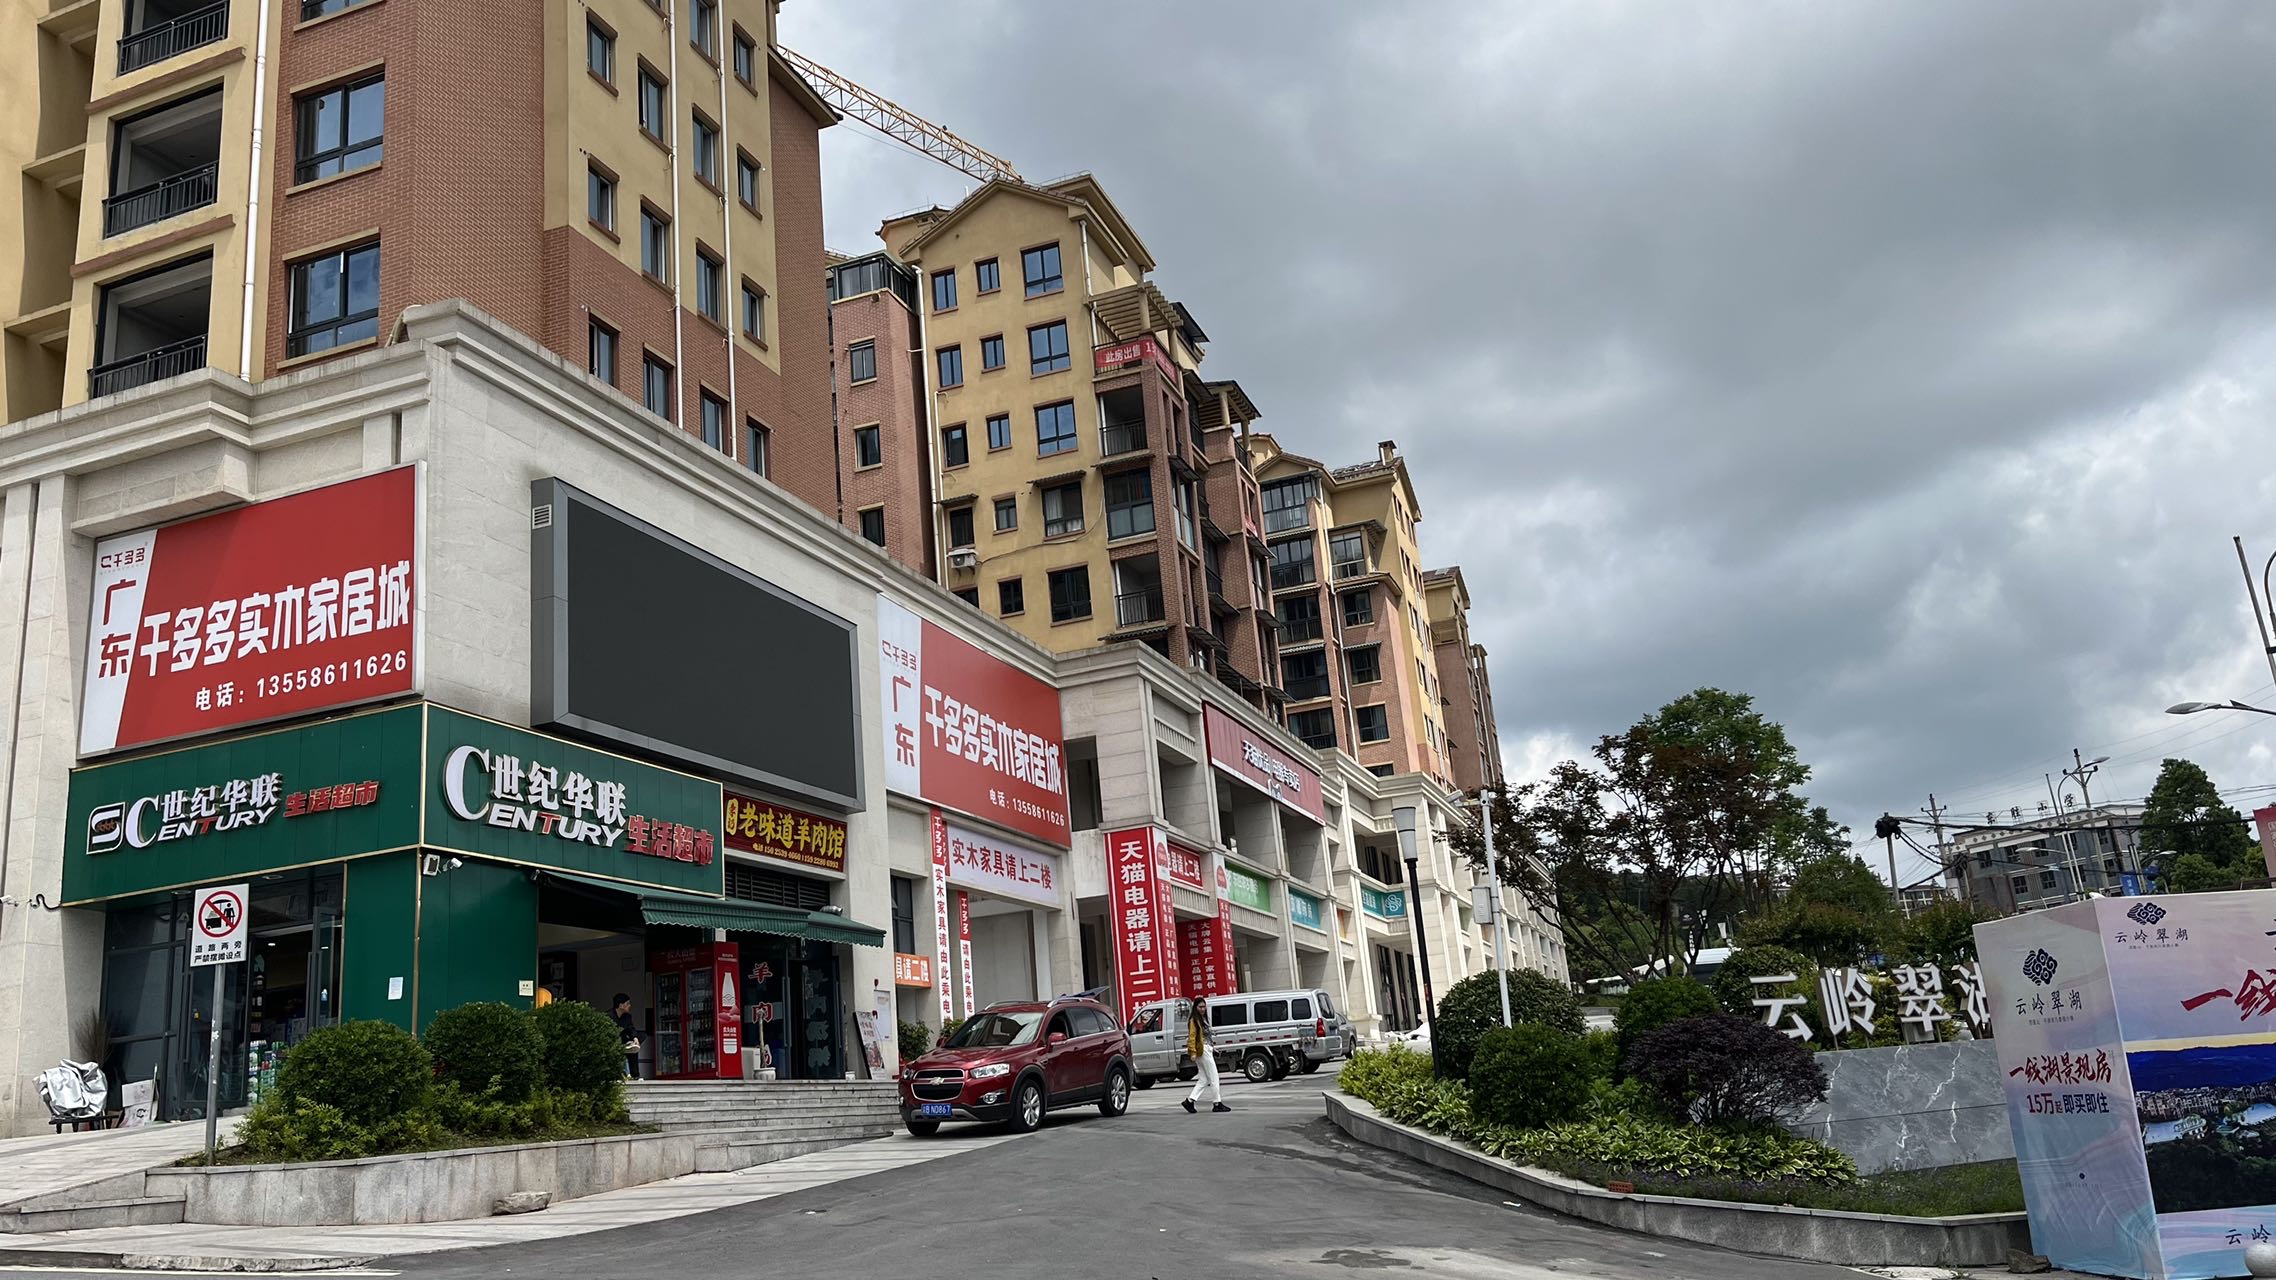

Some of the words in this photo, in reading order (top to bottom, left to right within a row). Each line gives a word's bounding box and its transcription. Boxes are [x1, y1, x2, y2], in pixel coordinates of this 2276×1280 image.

[1105, 343, 1141, 363] 此房出售
[98, 579, 136, 679] 广东
[139, 560, 411, 679] 千多多实木家居城
[256, 650, 407, 699] 13558611626
[892, 675, 915, 768] 广东
[924, 684, 1062, 796] 千多多实木家居城
[161, 772, 282, 823] 世纪华联
[283, 780, 380, 818] 生活超市
[443, 745, 625, 848] CENTURY
[490, 754, 627, 827] 世纪华联
[1012, 797, 1065, 827] 13558611626
[125, 796, 276, 849] CENTURY
[624, 814, 716, 866] 生活超市
[738, 801, 845, 860] 老味道羊肉馆
[952, 837, 1052, 890] 实木家具请上二楼
[194, 950, 242, 963] 严禁摆摊设点
[195, 940, 242, 953] 道路两旁
[935, 868, 951, 1019] 实木家具请由此乘电
[2115, 927, 2188, 944] 云岭翠湖
[962, 943, 974, 1020] 请由此乘电
[2016, 989, 2082, 1015] 云岭翠湖
[2009, 1048, 2112, 1085] 一线湖景现房
[2225, 1223, 2272, 1245] 云岭
